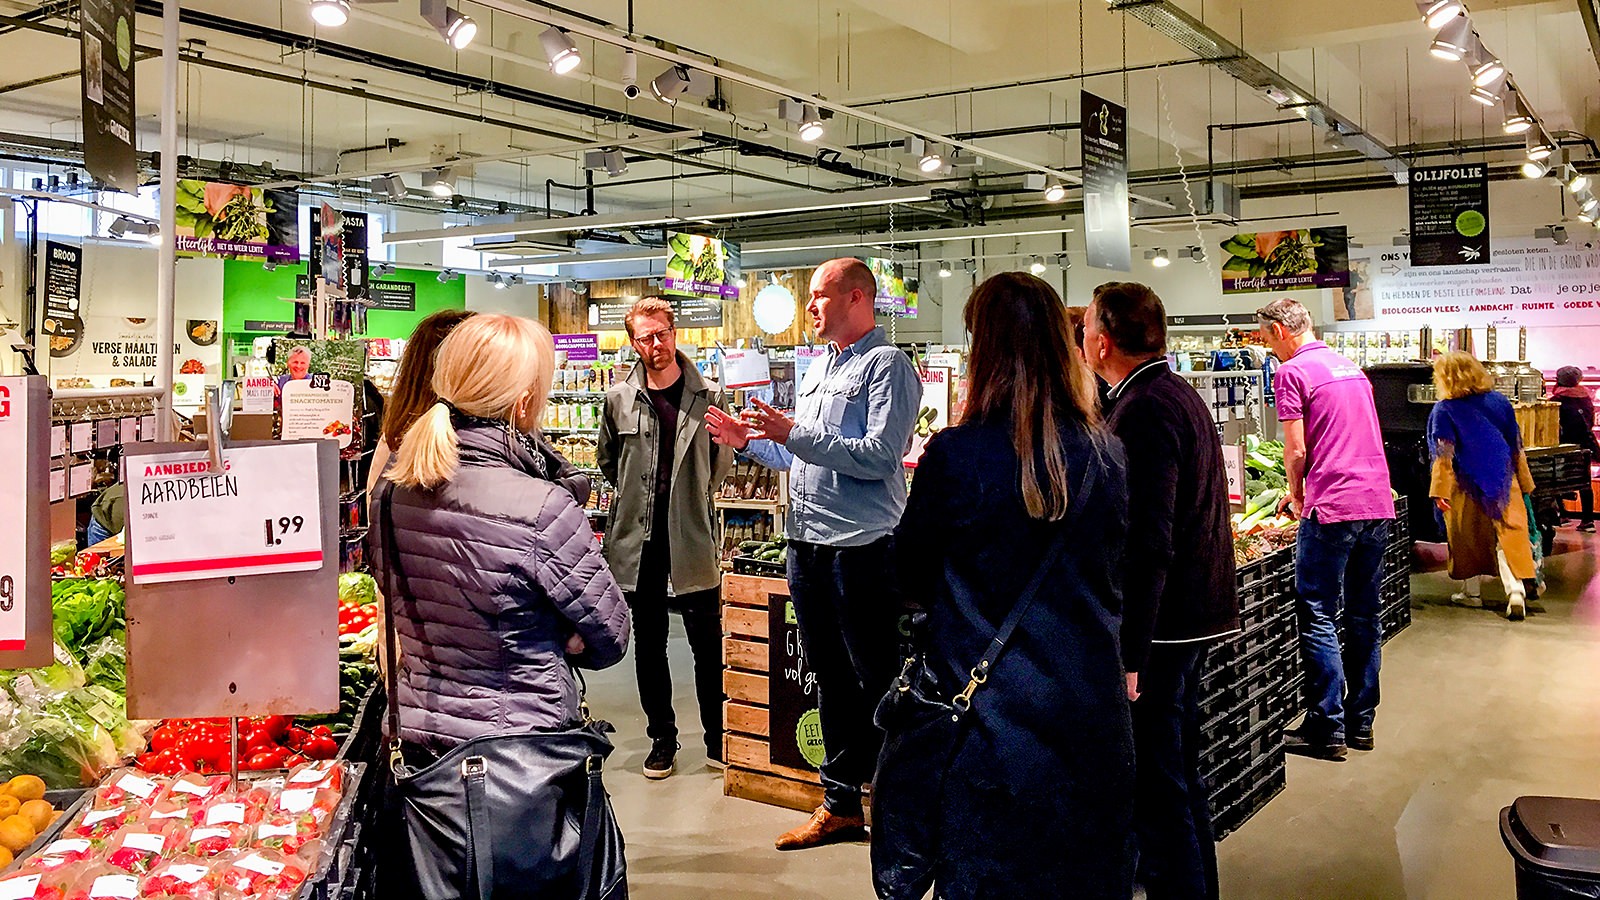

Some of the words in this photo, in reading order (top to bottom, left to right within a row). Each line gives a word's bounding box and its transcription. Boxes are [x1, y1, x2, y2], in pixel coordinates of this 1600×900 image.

[1414, 167, 1483, 182] OLIJFOLIE
[53, 248, 76, 262] BROOD
[217, 243, 227, 251] HET
[227, 243, 233, 251] IS
[234, 244, 248, 253] WEER
[248, 245, 264, 254] LENTE
[1493, 248, 1525, 256] gesloten
[1381, 253, 1400, 261] ONS
[1442, 267, 1480, 276] landschap
[1382, 292, 1391, 300] EN
[1392, 290, 1421, 299] HEBBEN
[1422, 290, 1431, 298] DE
[1433, 289, 1455, 297] BESTE
[1510, 286, 1532, 295] Dat
[1556, 285, 1569, 295] je
[1571, 284, 1587, 293] op
[1382, 306, 1432, 315] BIOLOGISCH
[1434, 305, 1461, 313] VLEES
[1469, 304, 1514, 312] AANDACHT
[1522, 302, 1555, 310] RUIMTE
[1563, 301, 1594, 309] GOEDE
[92, 341, 122, 354] VERSE
[112, 355, 120, 367] &
[313, 378, 329, 388] NL
[141, 474, 238, 505] AARDBEIEN
[264, 515, 304, 547] 1.99
[784, 656, 803, 686] vol
[803, 722, 820, 738] EET
